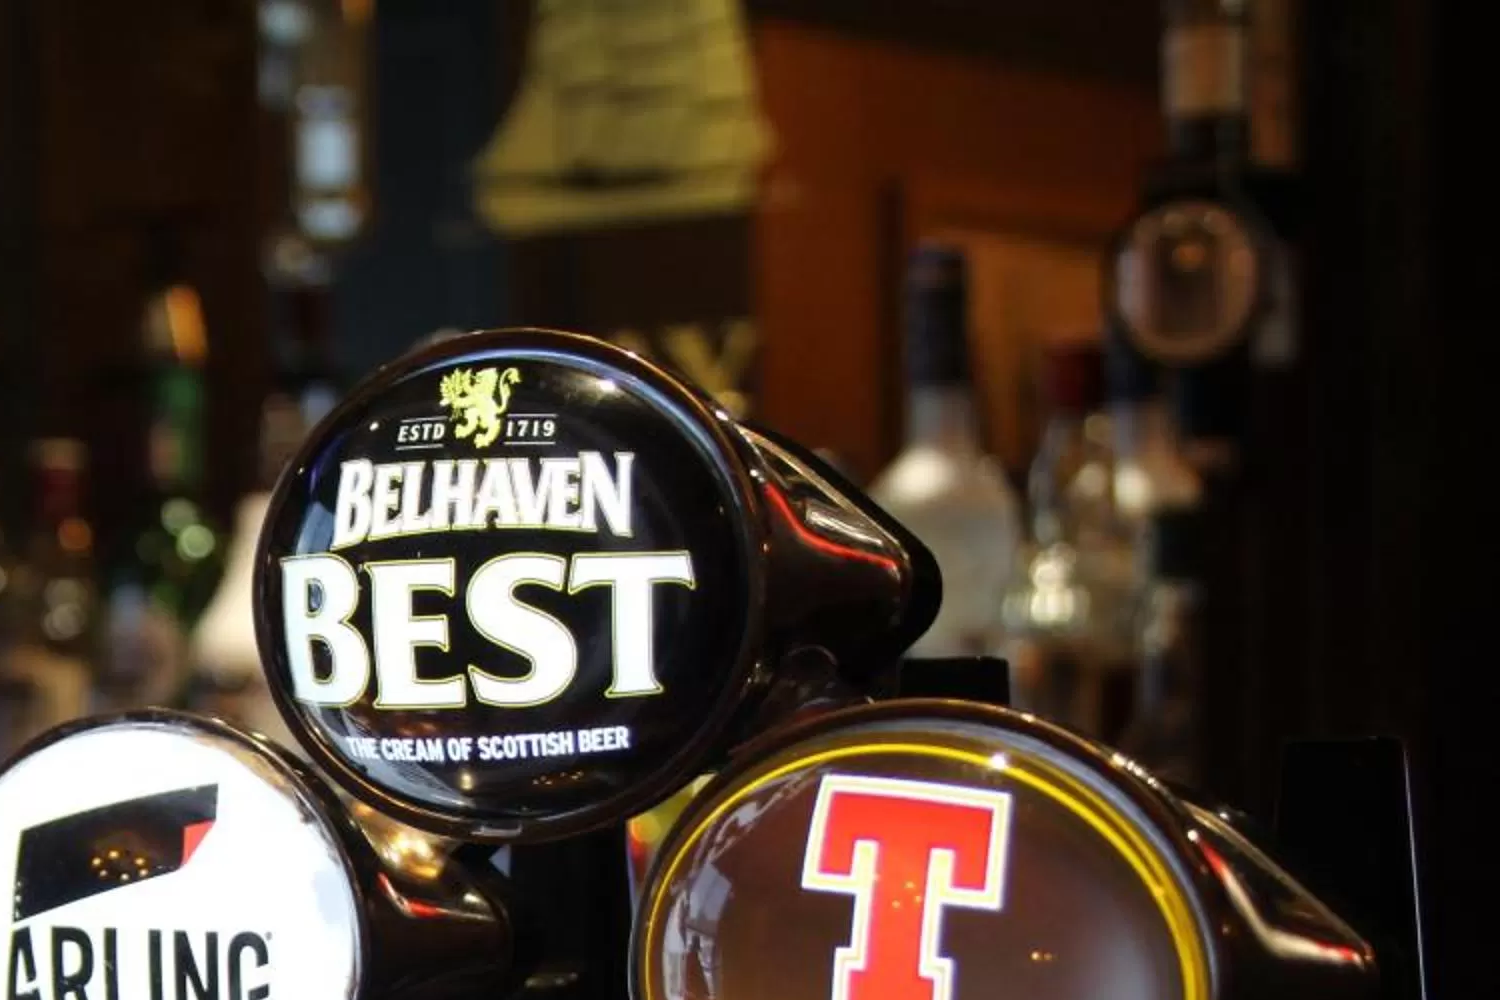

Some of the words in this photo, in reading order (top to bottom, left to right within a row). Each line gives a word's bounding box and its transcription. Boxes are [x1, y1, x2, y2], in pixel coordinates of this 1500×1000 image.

[397, 423, 446, 443] ESTD
[506, 420, 556, 437] 1719
[330, 450, 636, 552] BELHAVEN
[279, 551, 697, 710] BEST
[346, 736, 381, 760] THE
[379, 737, 445, 763] CREAM
[447, 737, 472, 761] OF
[477, 731, 575, 761] SCOTTISH
[578, 725, 630, 752] BEER
